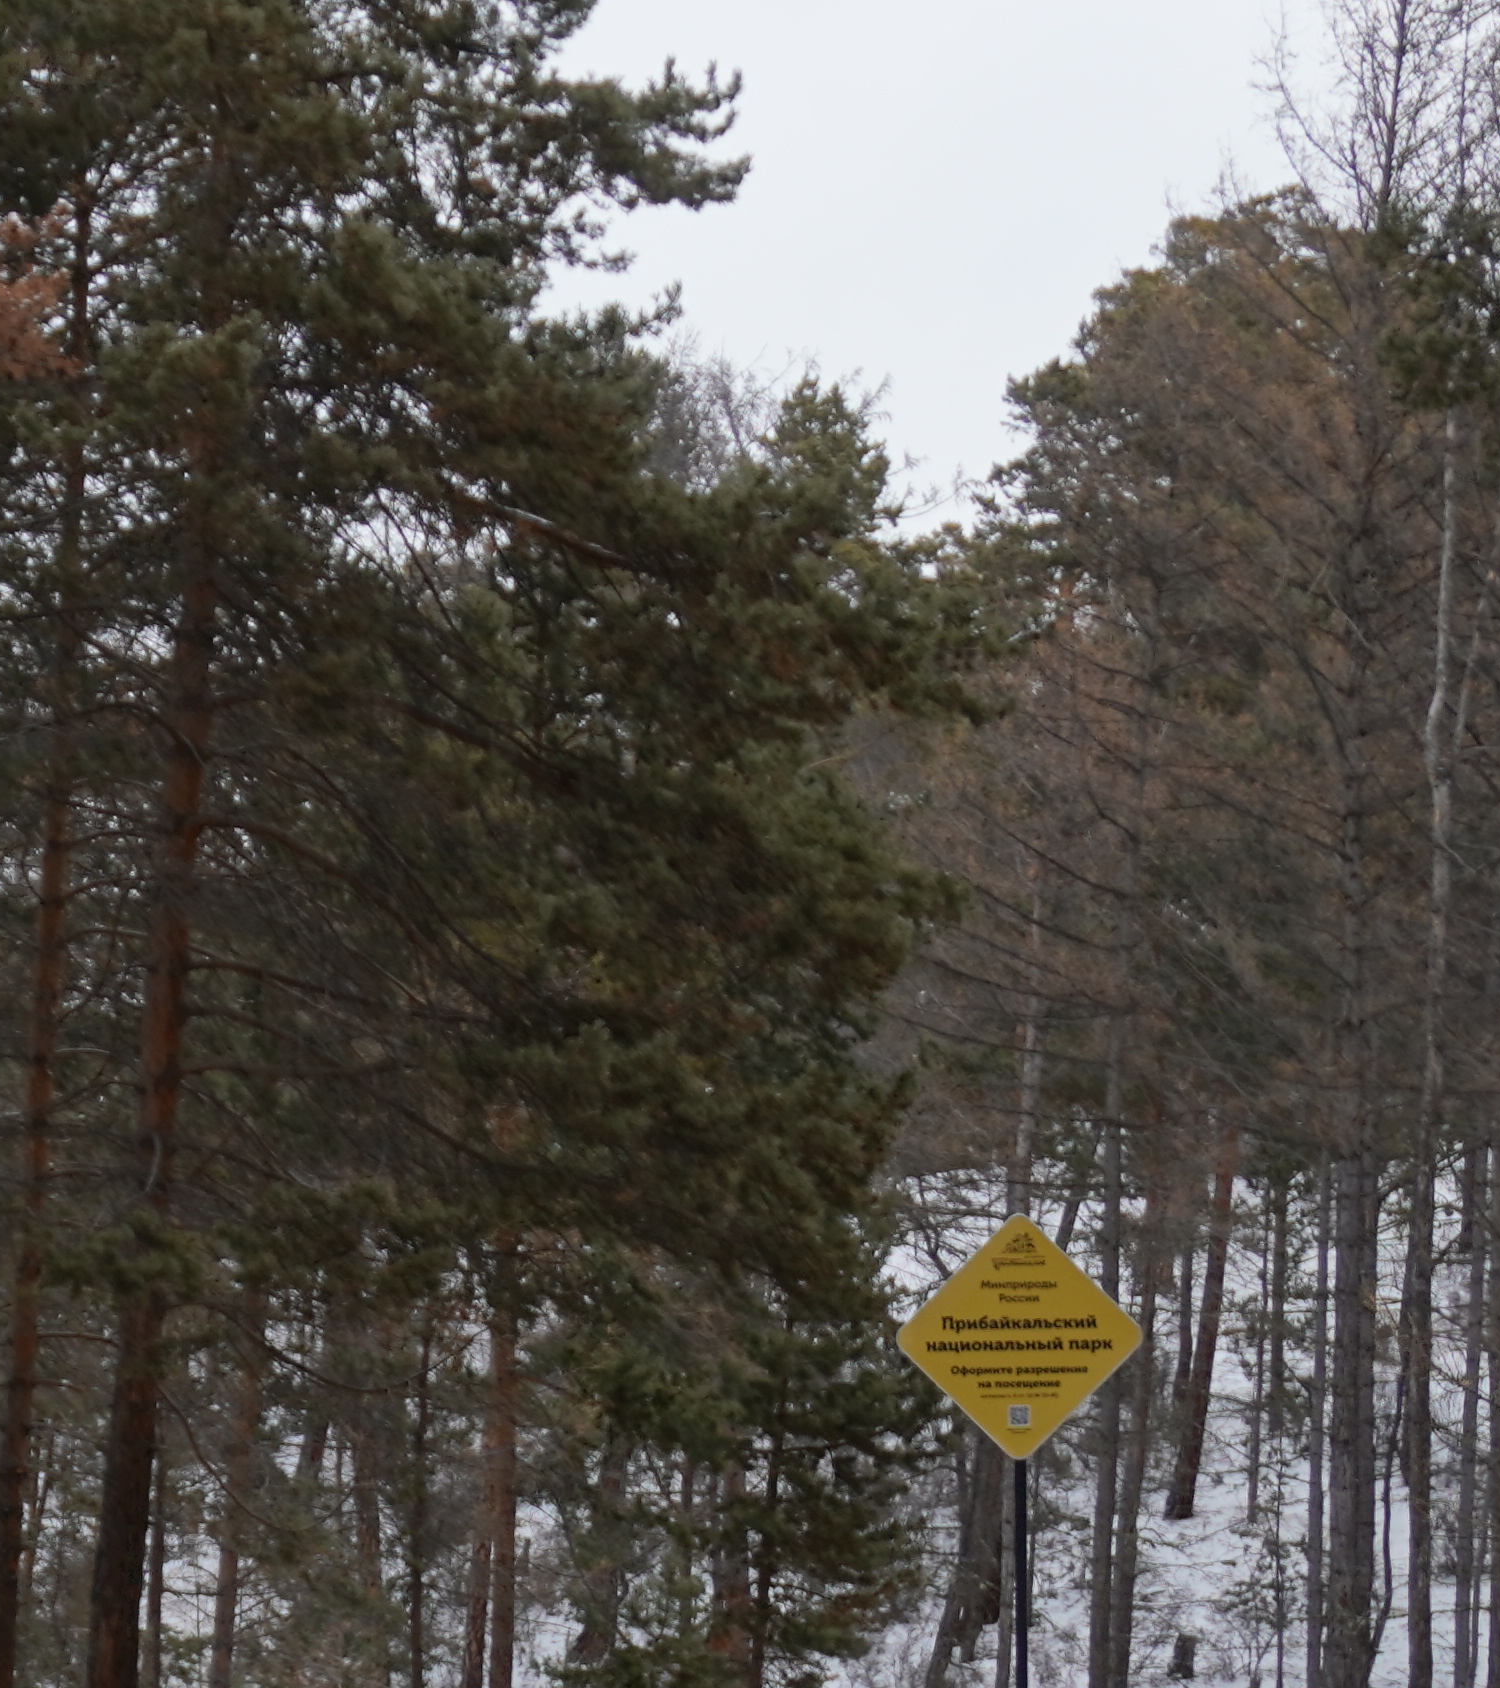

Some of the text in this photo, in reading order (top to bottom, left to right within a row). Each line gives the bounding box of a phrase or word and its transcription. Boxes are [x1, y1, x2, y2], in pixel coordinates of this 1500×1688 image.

[980, 1279, 1058, 1291] Минприроды
[998, 1293, 1040, 1303] России
[941, 1315, 1098, 1333] Прибайкальский
[926, 1337, 1113, 1353] национальный парк
[950, 1365, 1013, 1377] Оформите
[977, 1379, 1061, 1390] на посещение
